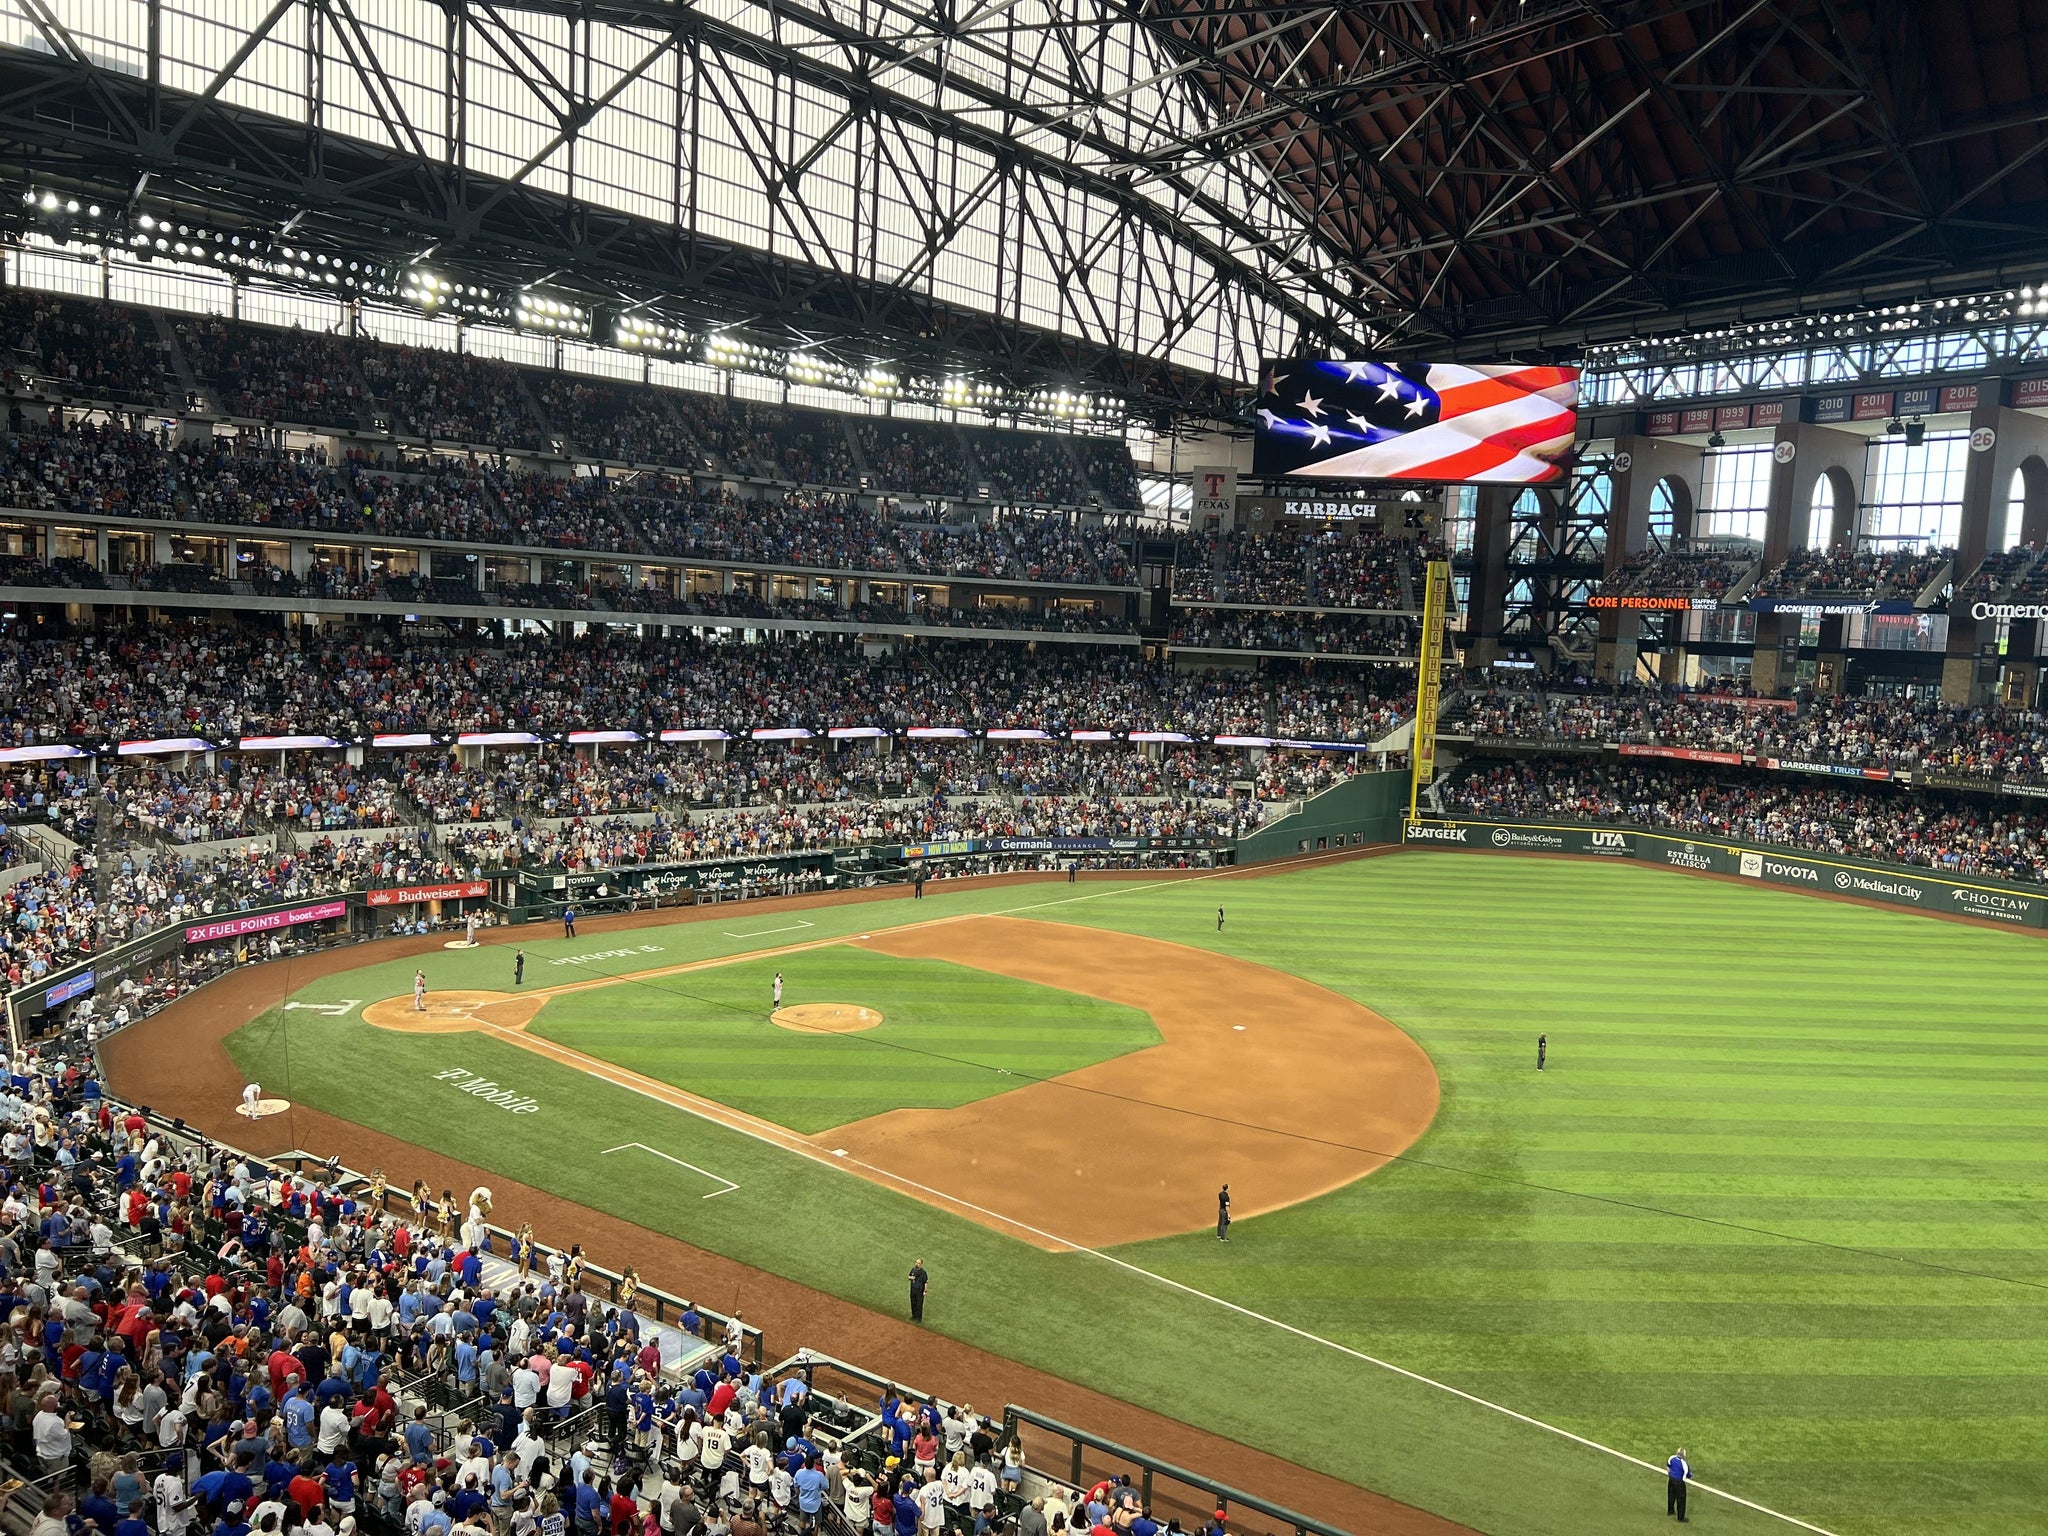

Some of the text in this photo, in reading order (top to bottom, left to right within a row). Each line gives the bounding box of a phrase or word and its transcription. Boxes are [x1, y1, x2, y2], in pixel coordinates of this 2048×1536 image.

[1949, 386, 1977, 399] 2012
[2020, 380, 2048, 393] 2015
[1862, 395, 1885, 406] 2011
[1904, 390, 1928, 403] 2011
[1760, 403, 1783, 415] 2010
[1818, 398, 1843, 410] 2010
[1652, 413, 1673, 424] 1996
[1687, 410, 1708, 421] 1998
[1722, 407, 1744, 418] 1999
[1972, 432, 1993, 446] 26
[1776, 446, 1793, 458] 34
[1615, 456, 1629, 468] 42
[1204, 473, 1225, 497] T
[1197, 499, 1230, 510] TEXAS
[1285, 501, 1377, 517] KARBACH
[1588, 596, 1691, 610] CORE PERSONNEL
[1773, 604, 1864, 614] LOCKHEED MARTIN
[1433, 581, 1443, 642] BRING
[1430, 646, 1438, 683] THE
[1426, 686, 1435, 734] HEAT
[1780, 760, 1832, 773] GARDENERS
[1833, 766, 1861, 776] TRUST
[1934, 778, 1960, 786] WORLD
[1407, 826, 1467, 842] SEATGEEK
[1592, 832, 1625, 847] UTA
[1001, 839, 1053, 849] Germania
[1667, 851, 1711, 864] ESTRELLA
[1727, 848, 1740, 856] 372
[1670, 858, 1707, 869] JALISCO
[709, 867, 734, 882] Kroger
[754, 863, 779, 879] Kroger
[1765, 862, 1819, 881] TOYOTA
[567, 876, 596, 885] TOYOTA
[660, 872, 688, 889] Kroger
[398, 888, 461, 902] Budweiser
[1853, 877, 1922, 900] Medical City
[1959, 890, 2030, 911] CHOCTAW
[289, 911, 314, 923] boost
[1964, 906, 1989, 915] CASINOS
[1996, 912, 2022, 920] RESORTS
[191, 916, 280, 940] 2X FUEL POINTS
[286, 1411, 298, 1426] 53
[654, 1408, 662, 1419] 5
[707, 1439, 719, 1450] 19
[754, 1457, 759, 1466] 5
[777, 1482, 781, 1490] 5
[947, 1473, 958, 1486] 34
[974, 1480, 985, 1492] 34
[931, 1494, 943, 1508] 32
[412, 1518, 419, 1530] 6
